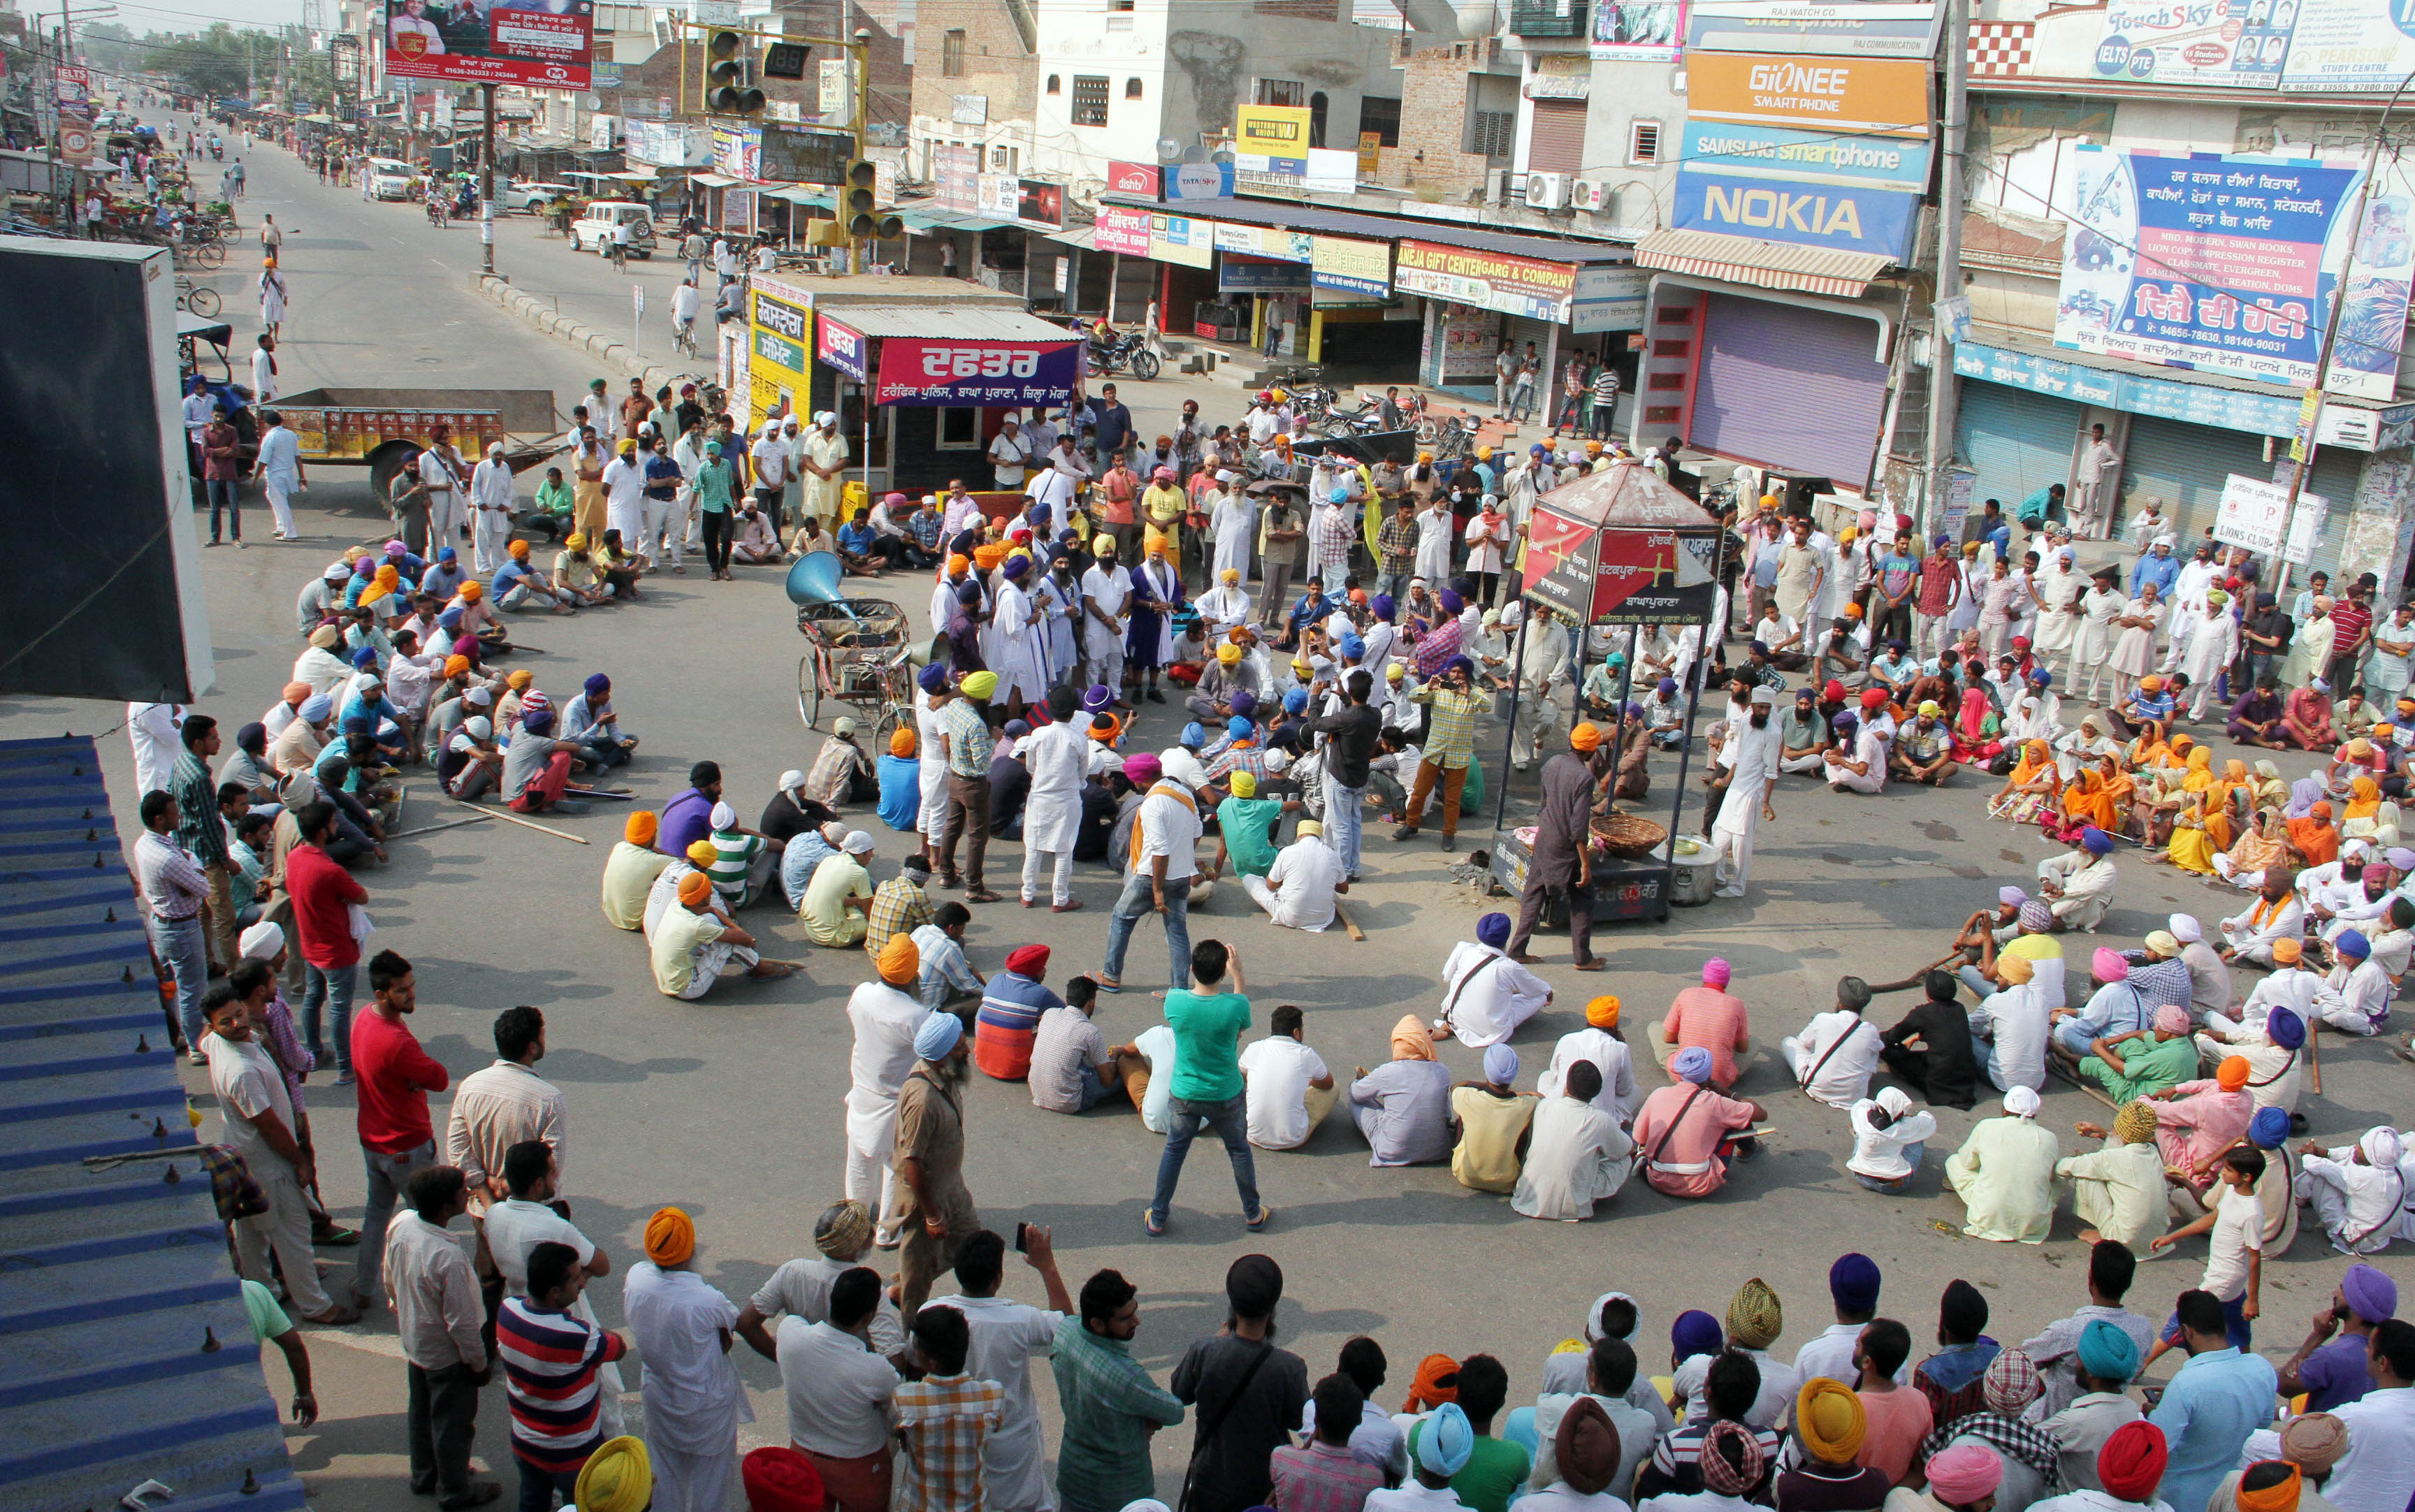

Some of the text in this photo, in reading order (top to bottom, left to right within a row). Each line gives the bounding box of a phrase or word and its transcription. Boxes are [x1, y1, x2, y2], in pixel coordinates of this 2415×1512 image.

[1789, 8, 1820, 17] WATCH
[2108, 6, 2213, 33] Touch Sky
[1853, 40, 1920, 50] RAJ COMMUNICATION
[2098, 45, 2128, 64] IELTS
[2131, 56, 2152, 70] PTE
[2194, 51, 2225, 59] Students
[57, 68, 86, 78] IELTS
[445, 67, 490, 77] 01636-242333
[2321, 64, 2389, 73] STUDY CENTRE
[559, 79, 586, 87] Finance
[1753, 96, 1839, 112] SMART PHONE
[1248, 120, 1275, 129] WESTERN
[1256, 129, 1275, 137] UNION
[1697, 137, 1901, 169] SAMSUNG smartphone
[1119, 178, 1143, 191] dishtv
[2171, 170, 2301, 194] ਹਰ ਕਲਾਸ ਦੀਆਂ ਕਿਤਾਬਾਂ,
[2147, 187, 2185, 205] ਕਾਪੀਆਂ,
[2217, 194, 2231, 207] ਦਾ
[2235, 196, 2267, 212] ਸਮਾਨ,
[1704, 185, 1862, 239] NOKIA
[2188, 210, 2272, 230] ਸਕੂਲ ਬੈਗ ਆਦਿ
[1219, 228, 1248, 240] MoneyGram
[2161, 232, 2295, 255] MBD, MODERN, SWAN BOOKS,
[2147, 243, 2307, 269] LION COPY, IMPRESSION REGISTER,
[1398, 247, 1424, 268] ANEJA
[1426, 251, 1446, 271] GIFT
[1447, 254, 1481, 277] CENTER
[1481, 261, 1509, 279] GARG
[1511, 267, 1519, 278] &
[1522, 268, 1575, 289] COMPANY
[2168, 259, 2282, 279] CLASSMATE, EVERGREEN,
[2146, 267, 2179, 279] CAMLIN
[2222, 277, 2271, 291] CREATION,
[2274, 282, 2303, 294] DOMS
[2134, 282, 2308, 341] ਵਿਜੈ ਦੀ ਹੱਟੀ
[827, 324, 855, 358] ਦਫਤਰ
[2160, 326, 2221, 345] 94656-78630,
[2224, 335, 2286, 353] 98140-90031
[921, 347, 1041, 378] ਦਫਤਰ
[2025, 358, 2041, 370] ਦੀ
[2102, 334, 2136, 351] ਵਿਆਹ
[2189, 349, 2212, 363] ਲਈ
[2250, 358, 2282, 375] ਪਟਾਖੇ
[2332, 371, 2354, 385] ਹਨ
[1992, 366, 2029, 384] ਕੁਮਾਰ
[881, 382, 918, 398] ਟਰੈਫਿਕ
[921, 384, 952, 400] ਪੁਲਿਸ,
[958, 387, 982, 398] ਬਾਘਾ
[985, 388, 1017, 401] ਪੁਰਾਣਾ,
[1048, 386, 1069, 400] ਮੋਗਾ
[2265, 506, 2276, 521] P
[2219, 525, 2244, 541] LIONS
[2247, 533, 2270, 547] CLUB
[1598, 561, 1638, 579] ਕੋਟਕਪੂਰਾ
[1627, 597, 1680, 608] ਬਾਘਾਪੁਰਾਣਾ
